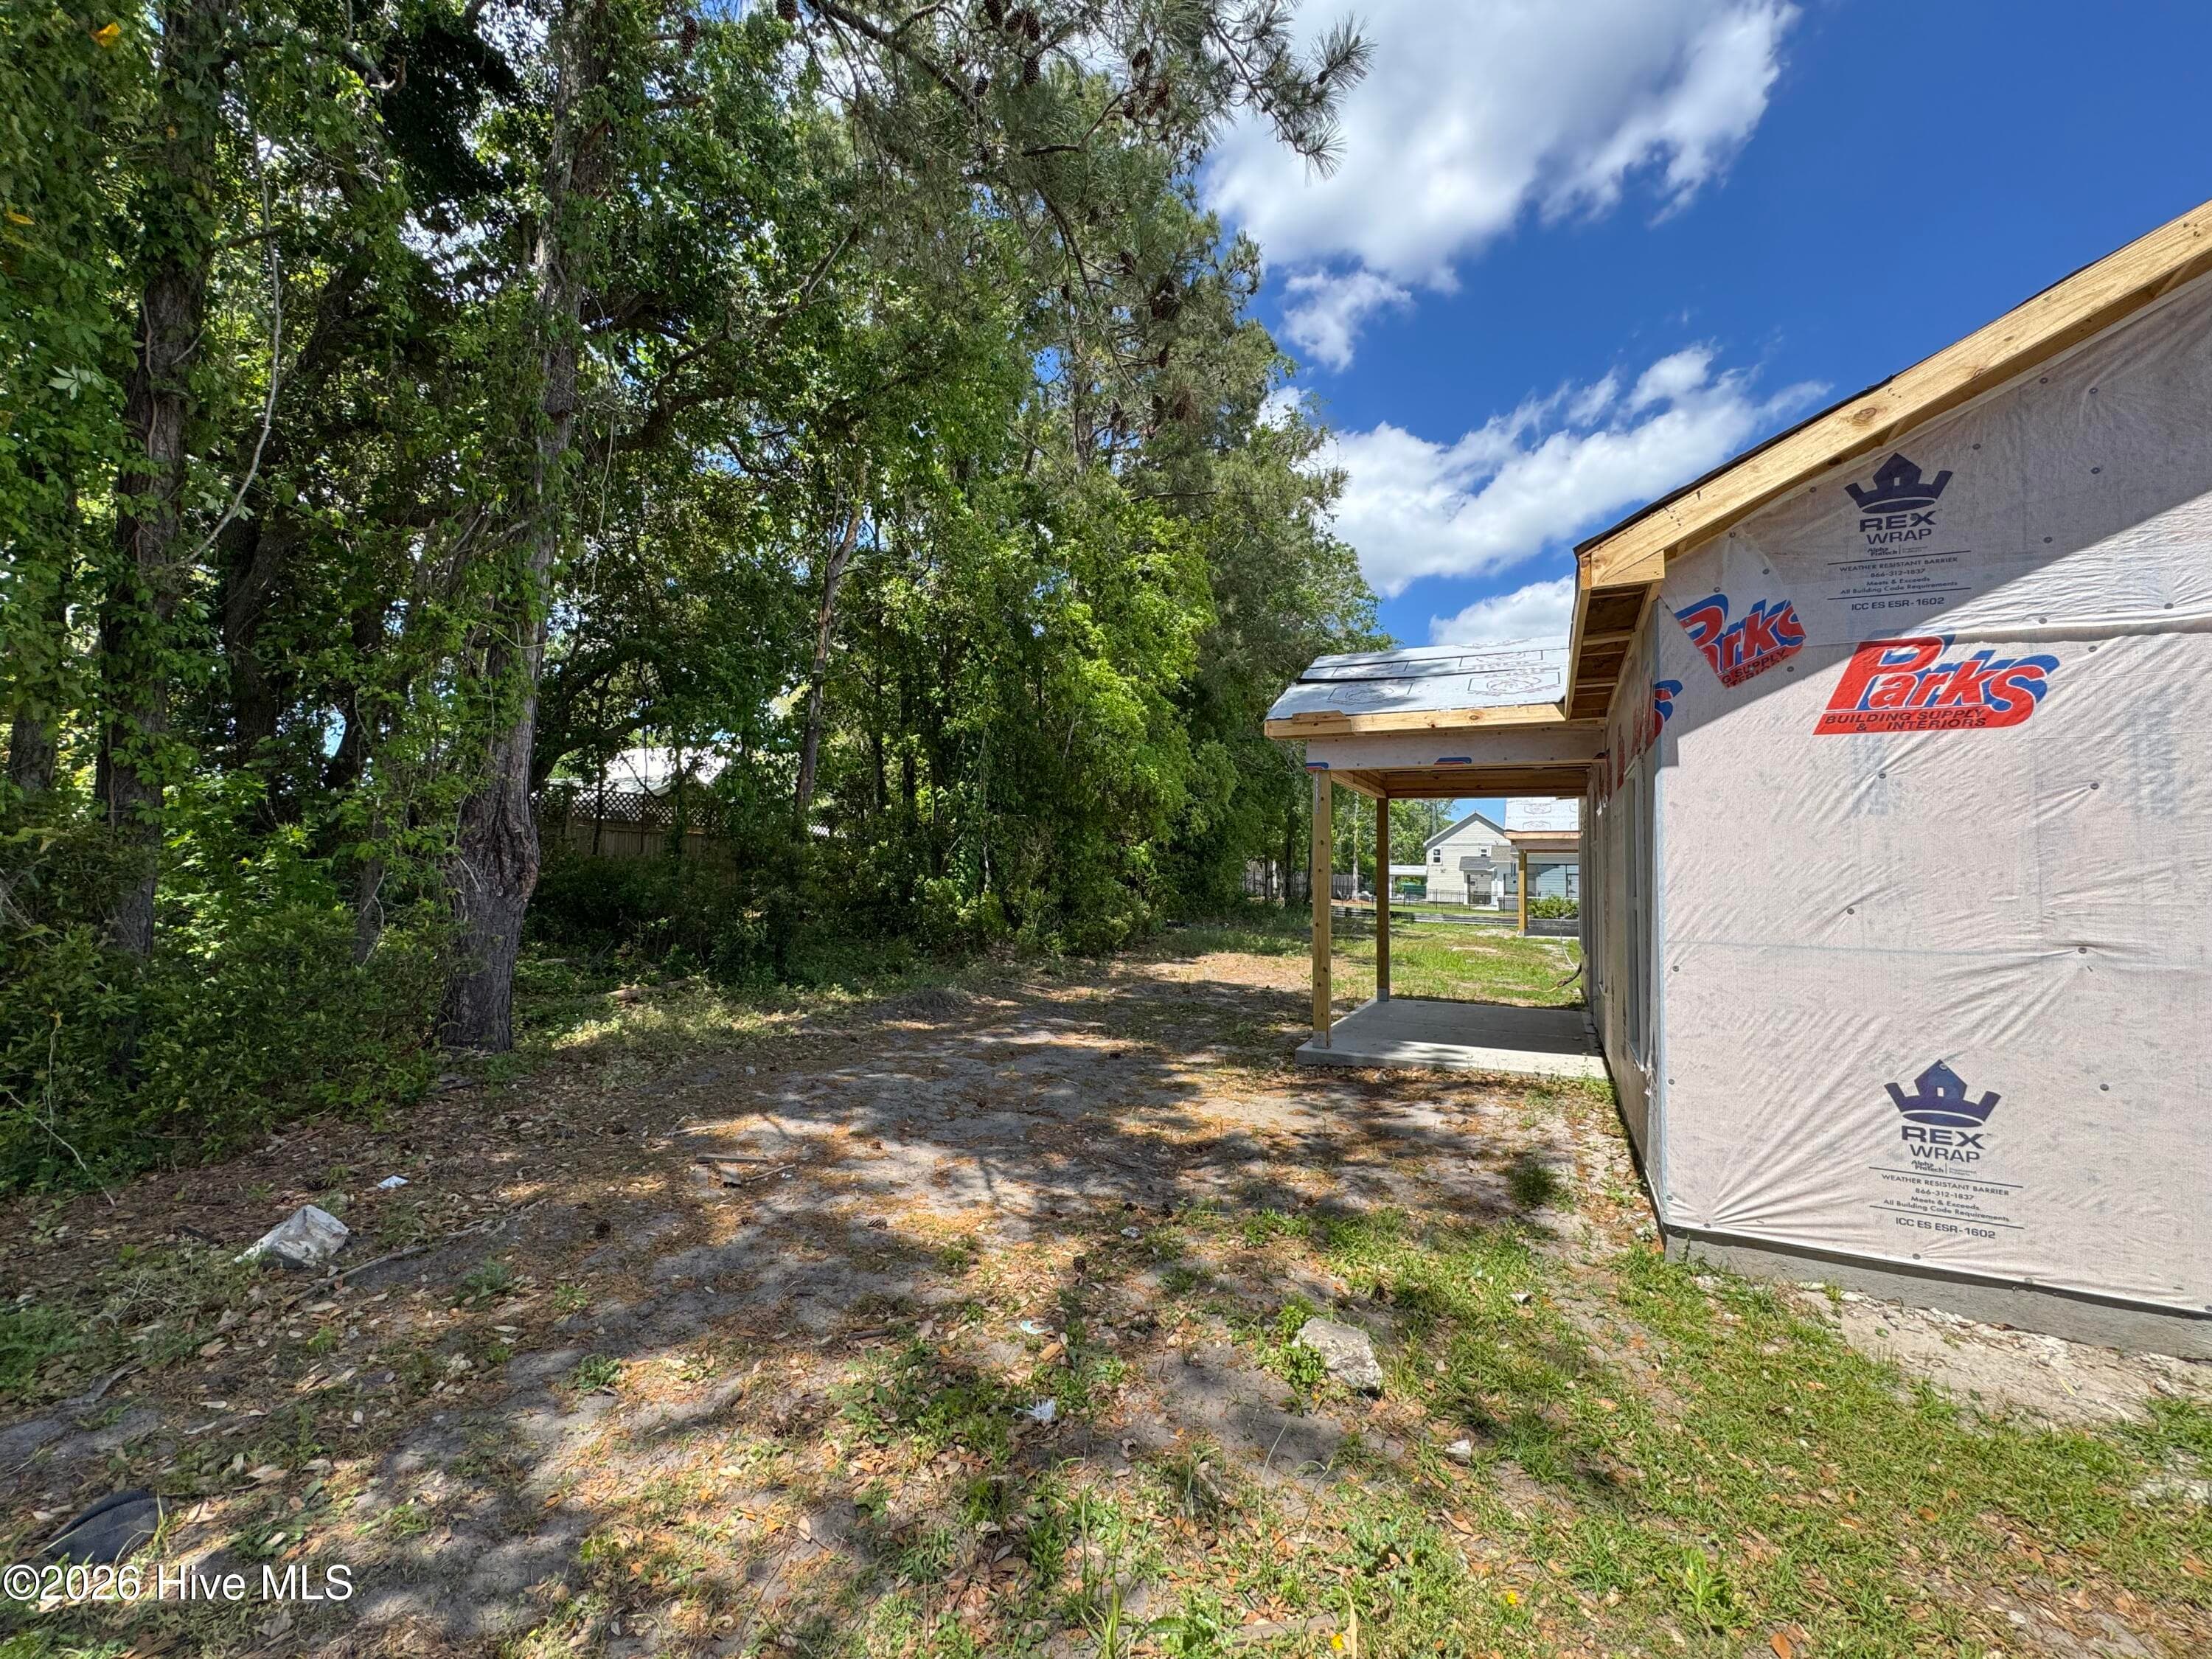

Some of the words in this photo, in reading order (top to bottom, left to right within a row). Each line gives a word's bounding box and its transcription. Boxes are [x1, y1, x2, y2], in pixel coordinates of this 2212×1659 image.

[1860, 510, 1936, 532] REX
[1866, 529, 1932, 545] WRAP
[1879, 560, 1922, 568] RESISTANT
[1924, 557, 1958, 565] BARRIER
[1871, 568, 1926, 578] 866-312-1837
[1907, 581, 1958, 591] Requirements
[1888, 597, 1944, 608] ESR-1602
[1826, 634, 2060, 712] Parks
[1825, 712, 1912, 724] BUILDING
[1917, 709, 1985, 720] SUPPLY
[1857, 723, 1867, 731] &
[1887, 717, 1986, 730] INTERIORS
[1902, 1125, 1986, 1150] REX
[1910, 1144, 1980, 1163] WRAP
[1881, 1174, 1921, 1184] WEATHER
[1924, 1180, 1969, 1191] RESISTANT
[1972, 1186, 2009, 1196] BARRIER
[1915, 1188, 1974, 1200] 866-312-1837
[1896, 1200, 1927, 1211] Building
[1930, 1206, 1952, 1214] Code
[1955, 1208, 2009, 1222] Requirements
[1911, 1196, 1935, 1204] Meets
[1947, 1201, 1980, 1211] Exceeds
[1896, 1217, 1914, 1227] ICC
[1917, 1220, 1932, 1229] ES
[1935, 1223, 1995, 1239] ESR-1602
